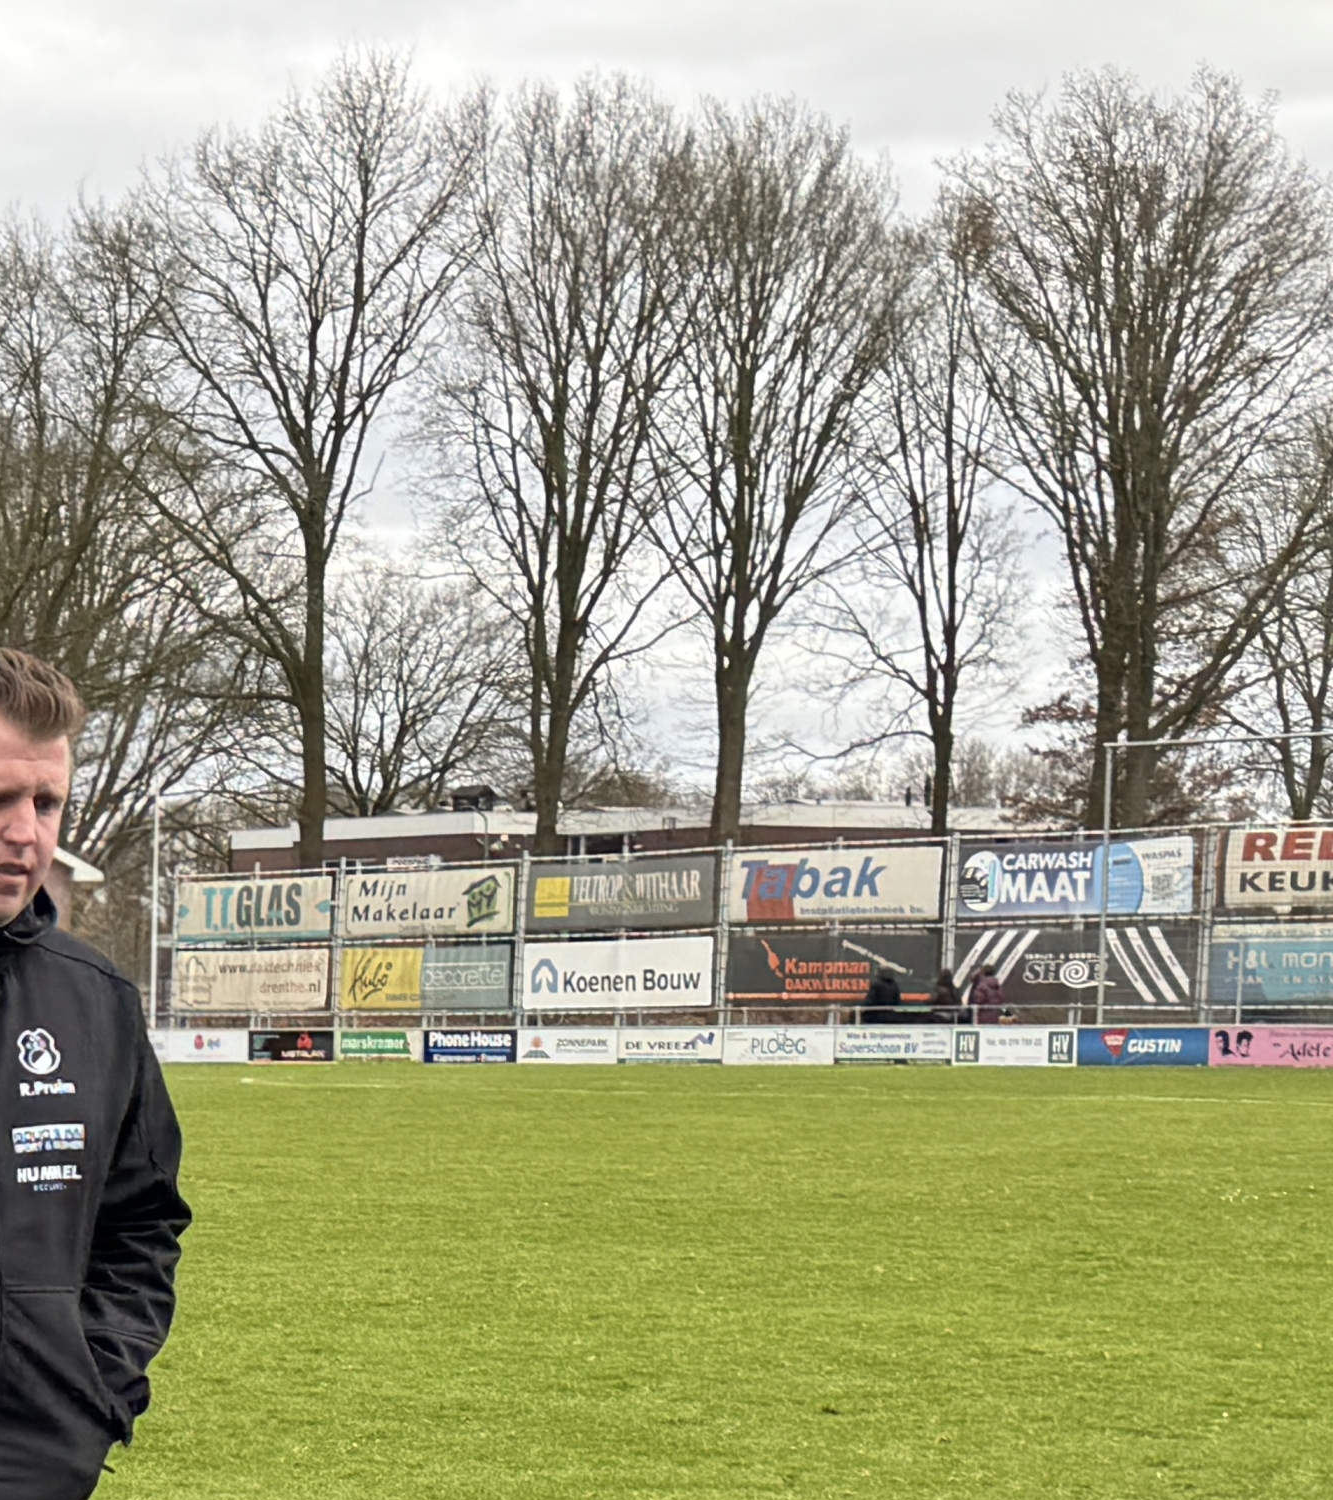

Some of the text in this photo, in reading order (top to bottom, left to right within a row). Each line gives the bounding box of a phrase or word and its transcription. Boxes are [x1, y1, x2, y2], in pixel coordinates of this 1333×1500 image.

[1002, 851, 1093, 871] CARWASH
[573, 875, 623, 902] VELTROP
[635, 870, 701, 900] WITHAAR
[740, 856, 888, 900] Tabak
[1000, 871, 1091, 903] MAAT
[359, 880, 407, 901] Mijn
[236, 883, 302, 927] GLAS
[351, 902, 457, 923] Makelaar
[784, 957, 870, 979] Kampman
[259, 980, 321, 994] drenthe.nl
[563, 968, 701, 993] Koenen Bouw
[784, 978, 870, 992] DAKWERKEN
[429, 1031, 512, 1048] Phone House
[625, 1041, 699, 1050] DE VREEZE
[959, 1035, 976, 1053] HV
[1052, 1035, 1069, 1053] HV
[1127, 1038, 1182, 1054] GUSTIN
[17, 1164, 83, 1183] HUMMEL
